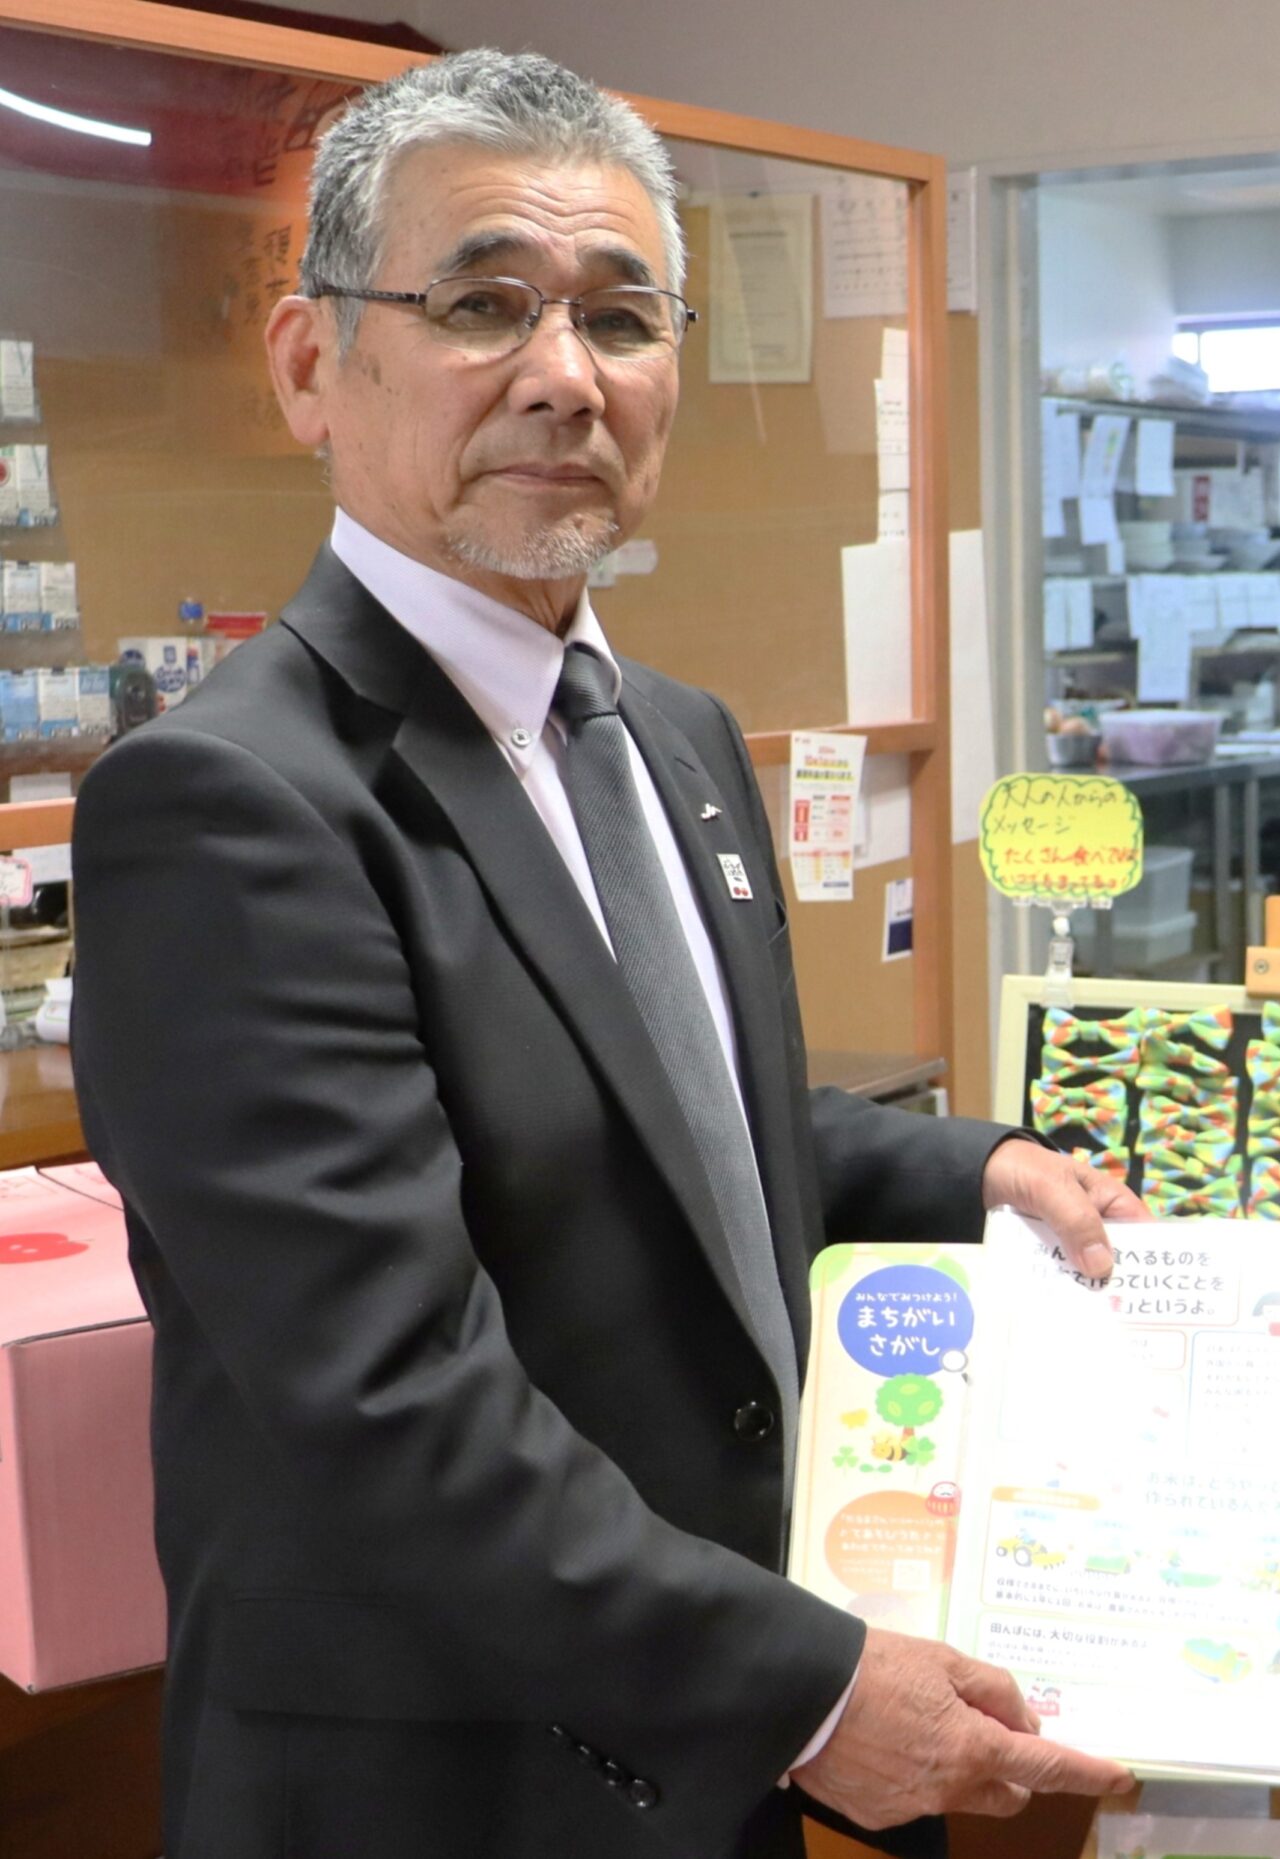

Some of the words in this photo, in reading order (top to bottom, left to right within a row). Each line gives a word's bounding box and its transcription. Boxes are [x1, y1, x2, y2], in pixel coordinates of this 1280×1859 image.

[993, 815, 1076, 836] メッセージ
[857, 1305, 956, 1328] まちがい
[869, 1333, 941, 1357] さがし
